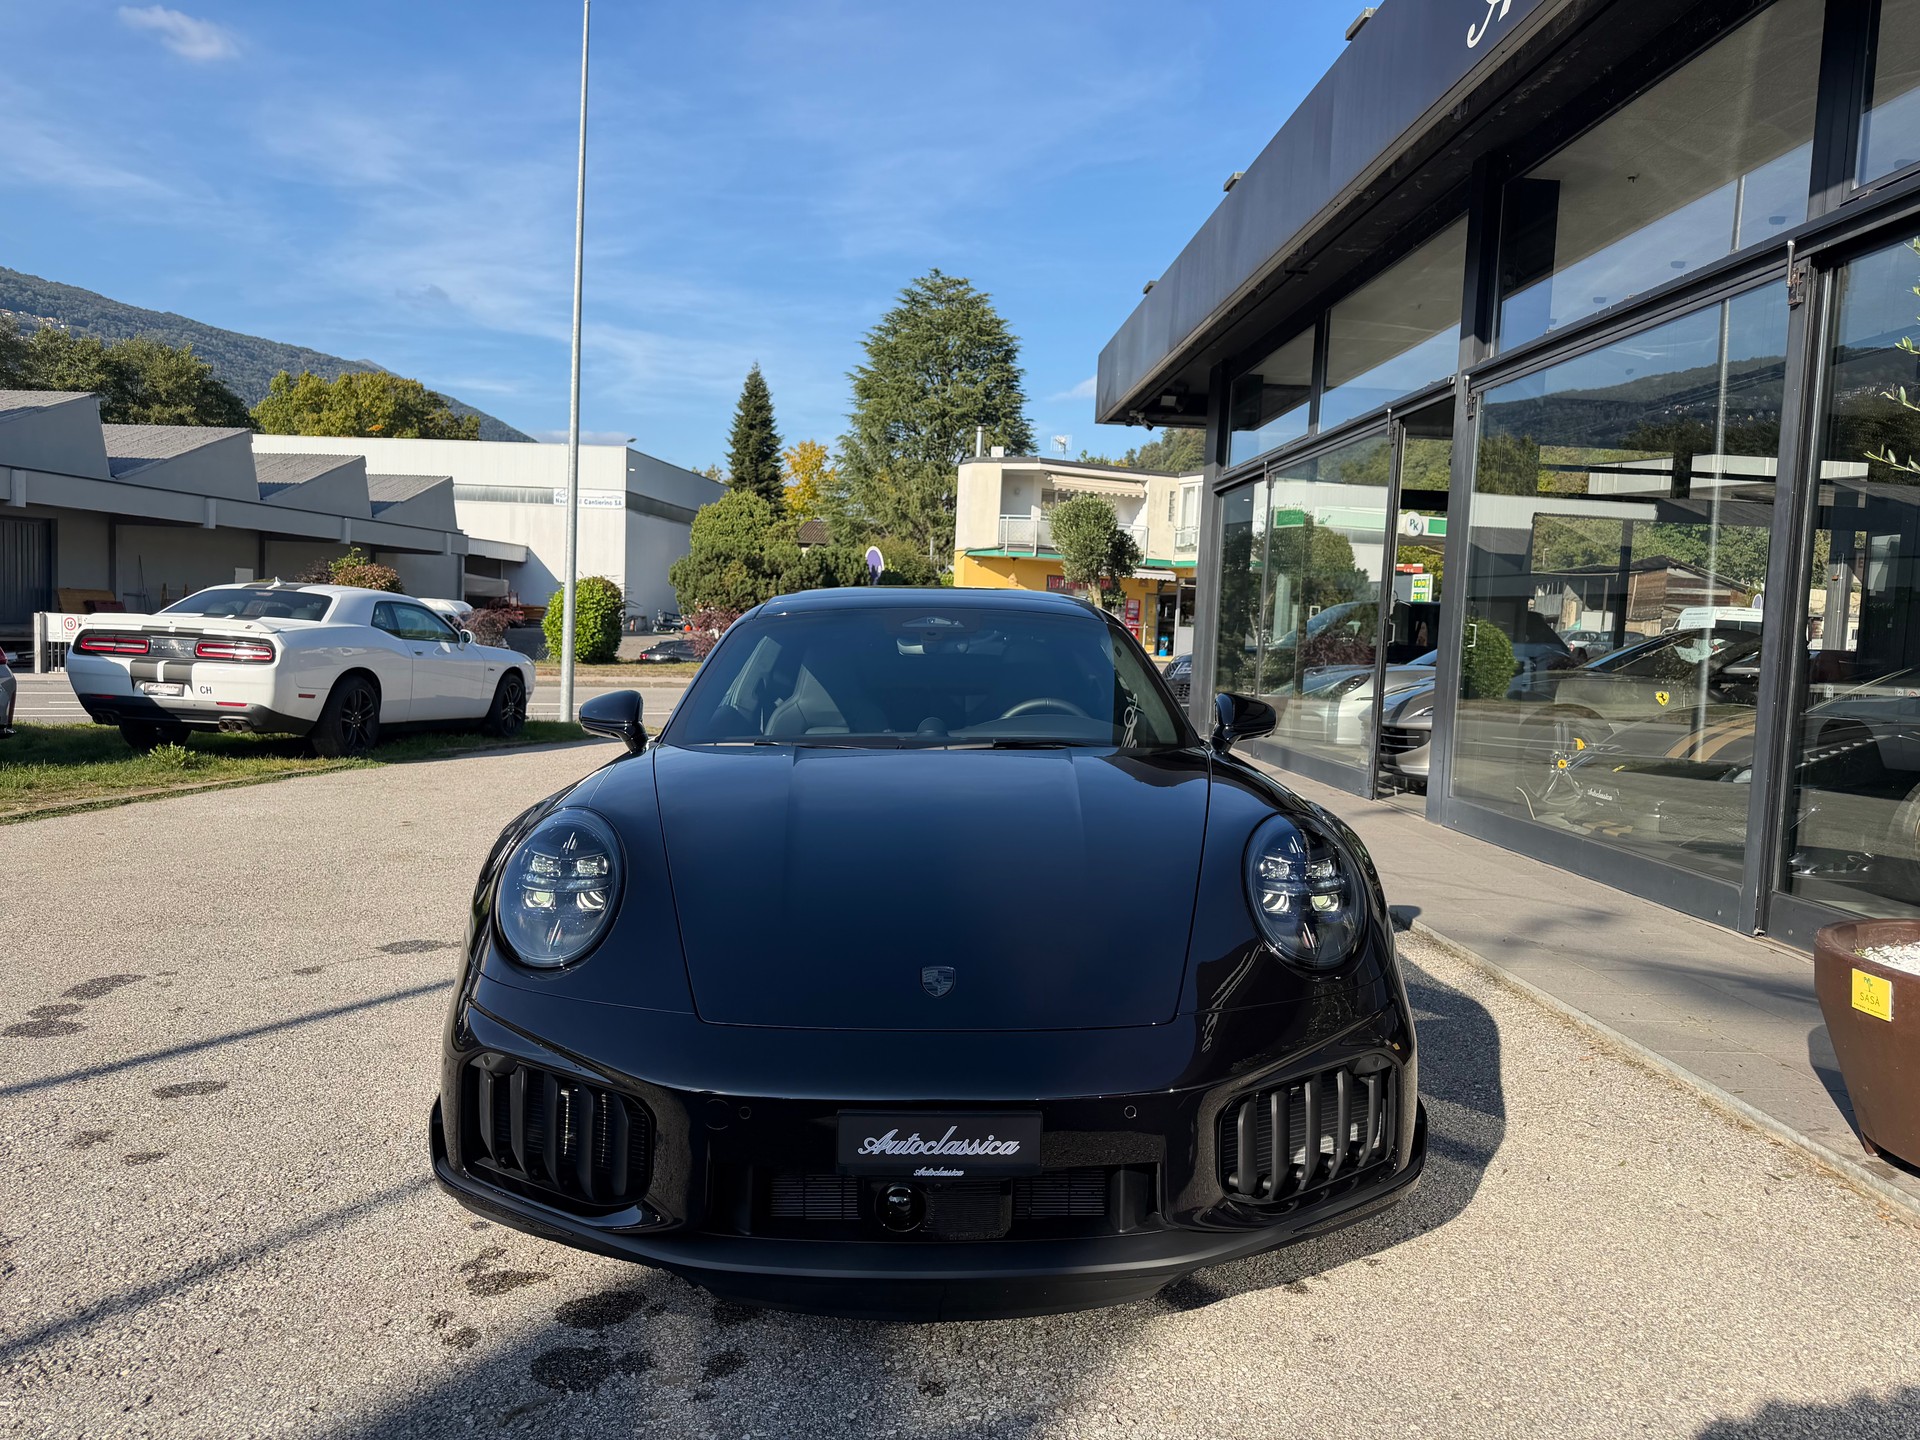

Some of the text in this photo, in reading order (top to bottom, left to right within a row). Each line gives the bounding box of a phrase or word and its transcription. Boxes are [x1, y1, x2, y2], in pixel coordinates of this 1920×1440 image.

[200, 685, 212, 694] CH
[857, 1125, 1021, 1156] Autoclassica
[913, 1166, 965, 1176] Autoclassica
